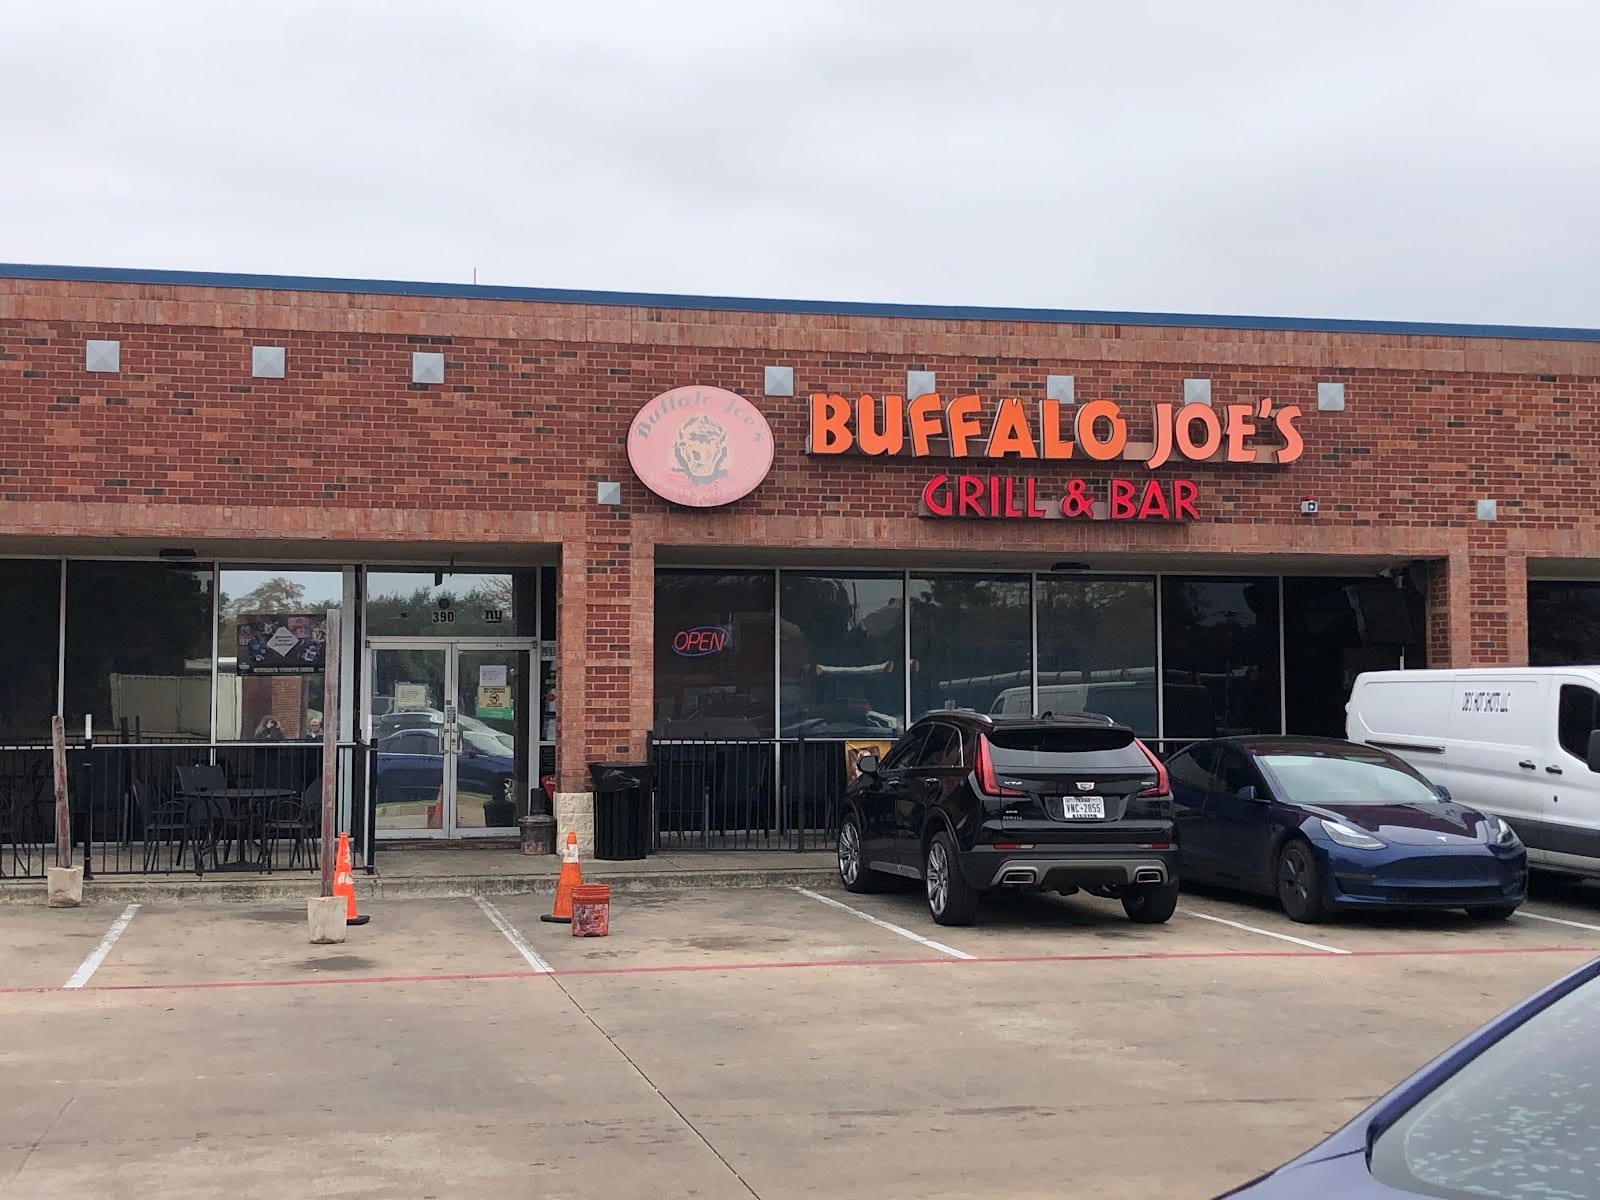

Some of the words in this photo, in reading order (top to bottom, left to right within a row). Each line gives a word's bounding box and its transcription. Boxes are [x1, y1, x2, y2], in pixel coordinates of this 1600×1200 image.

[809, 392, 1128, 461] BUFFALO
[1146, 397, 1304, 470] JOE'S
[922, 474, 1047, 518] GRILL
[1061, 478, 1095, 519] &
[1109, 479, 1201, 520] BAR
[432, 610, 455, 623] 390
[674, 630, 725, 652] OPEN
